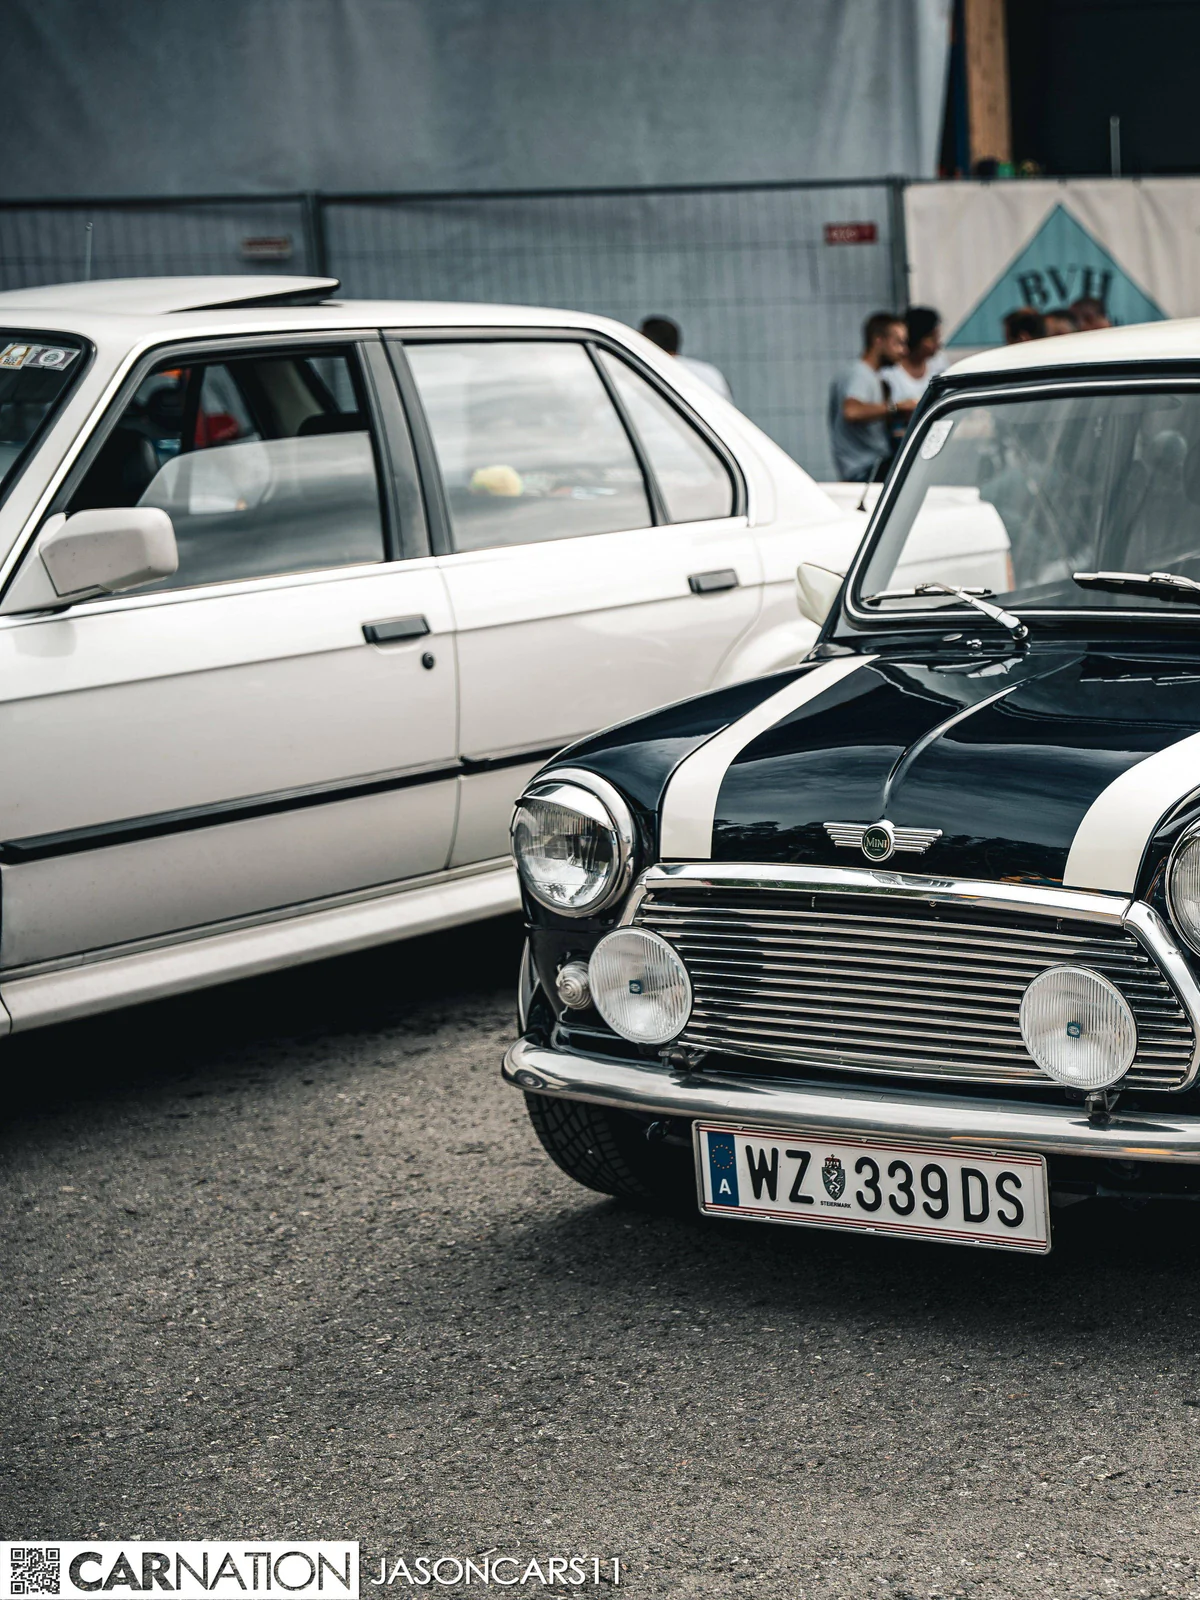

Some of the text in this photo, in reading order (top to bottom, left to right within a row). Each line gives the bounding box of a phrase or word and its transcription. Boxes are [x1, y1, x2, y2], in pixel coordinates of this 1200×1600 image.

[1016, 263, 1113, 315] BVH
[719, 1178, 732, 1195] A
[745, 1144, 815, 1205] WZ
[820, 1200, 852, 1209] STEIERMARK
